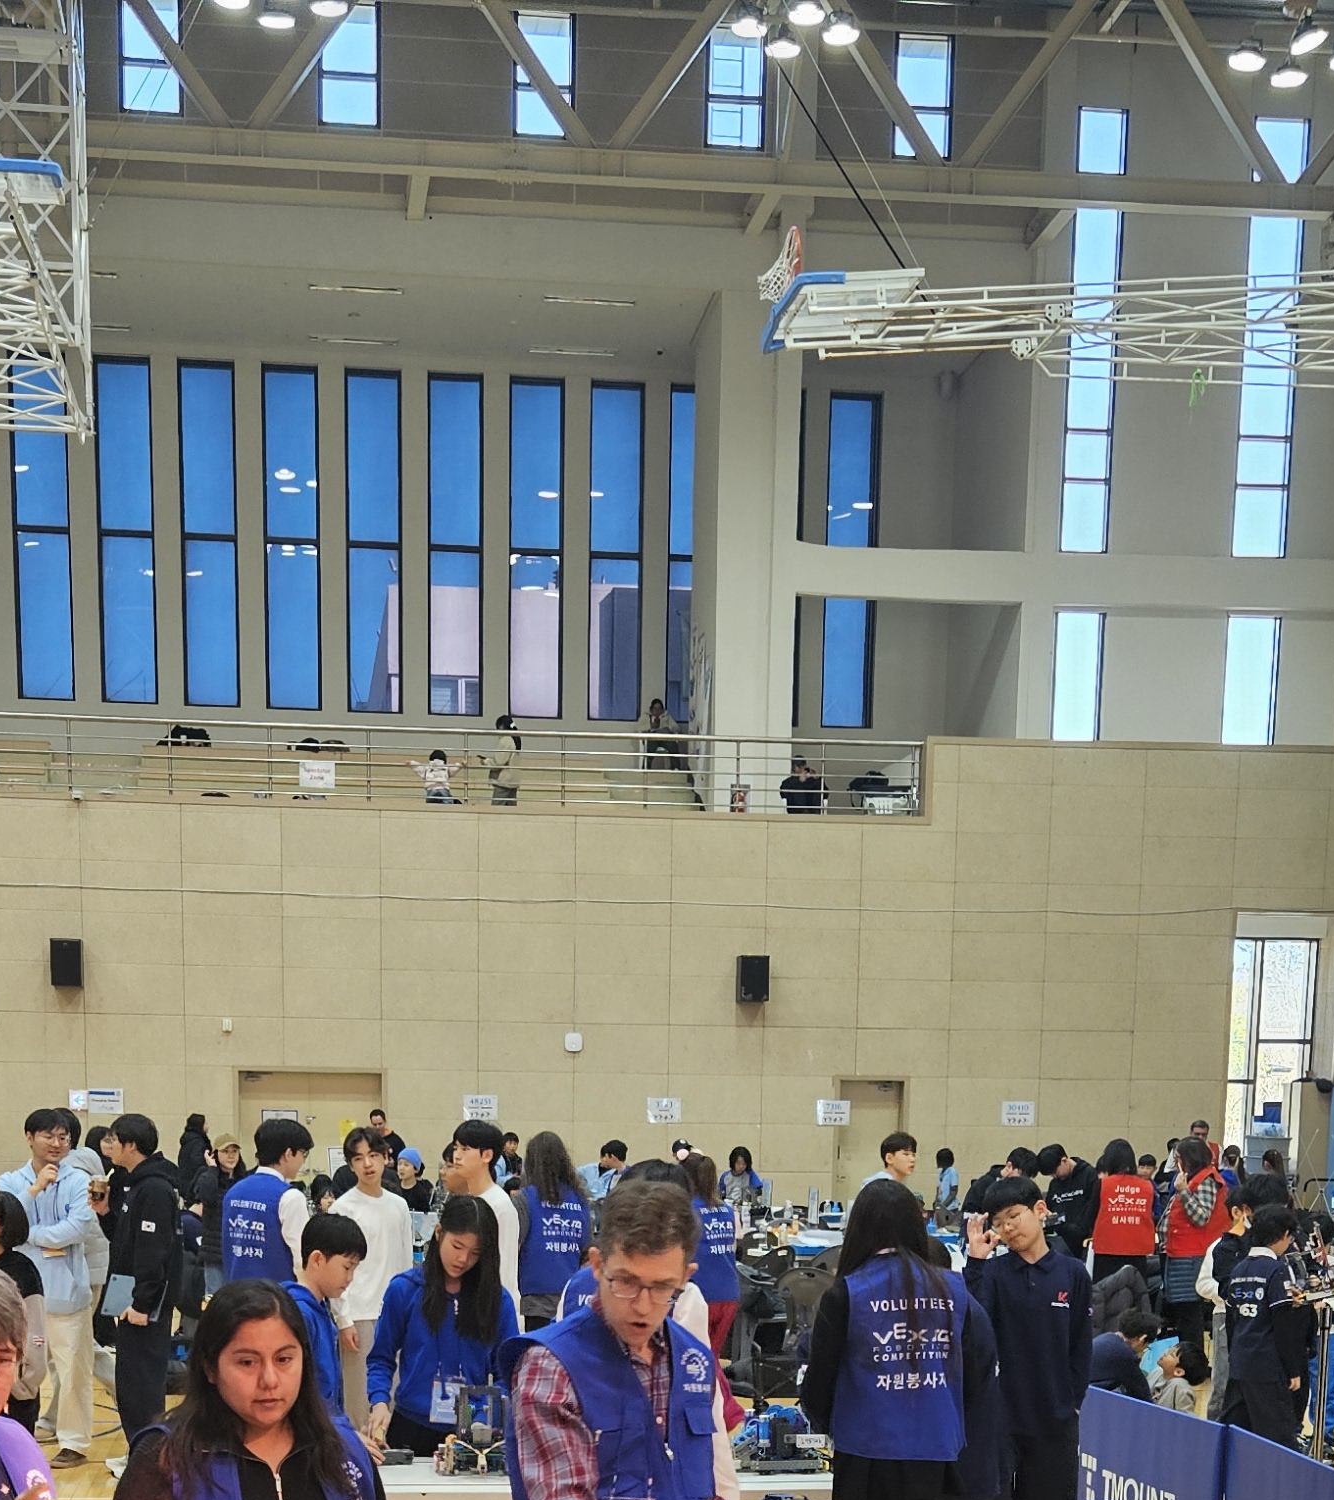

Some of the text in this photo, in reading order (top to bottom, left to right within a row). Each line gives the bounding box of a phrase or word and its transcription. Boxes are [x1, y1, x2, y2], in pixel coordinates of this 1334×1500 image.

[1114, 1185, 1141, 1195] Judge
[1108, 1195, 1135, 1204] VEX
[542, 1213, 571, 1227] VEX
[873, 1323, 929, 1345] VEX
